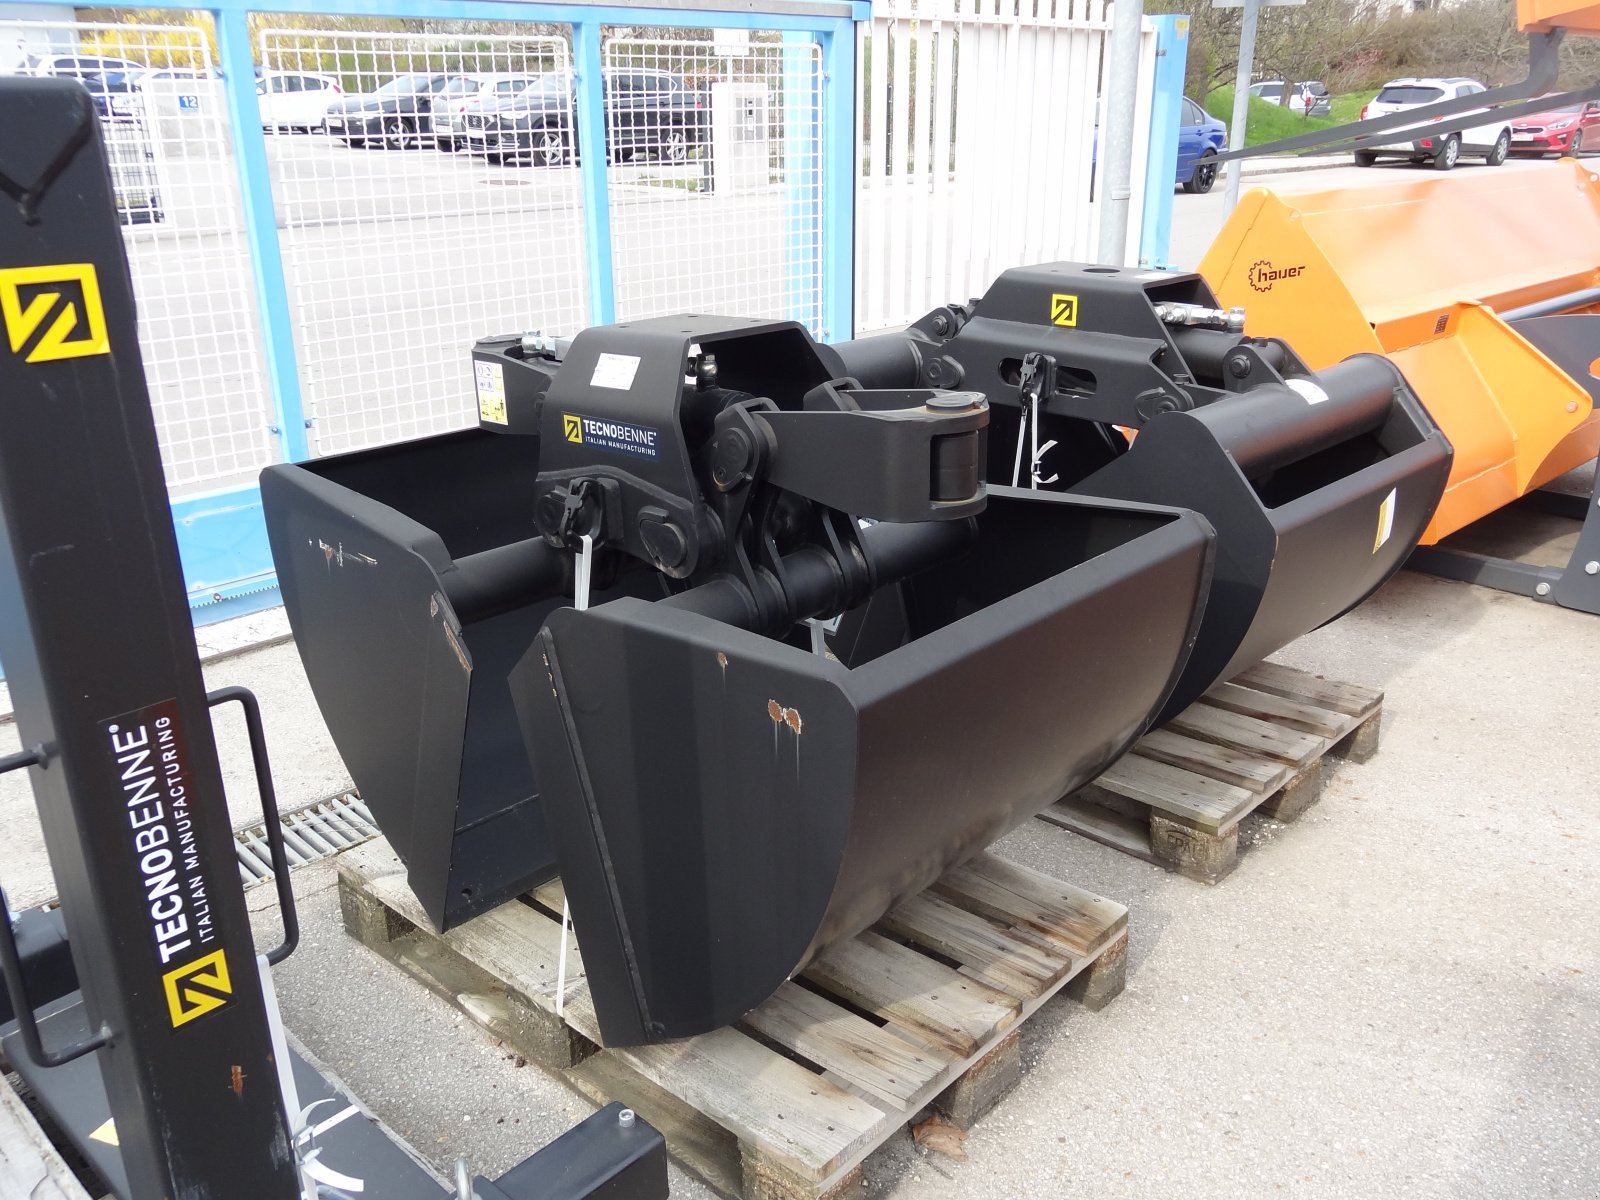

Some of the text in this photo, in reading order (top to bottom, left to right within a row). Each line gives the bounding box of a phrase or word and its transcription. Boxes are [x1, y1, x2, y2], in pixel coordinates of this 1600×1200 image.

[182, 96, 198, 108] 12
[1257, 265, 1306, 283] hauer
[585, 436, 656, 456] ITALIAN MANUFACTURING
[155, 716, 215, 943] ITALIAN MANUFACTURING
